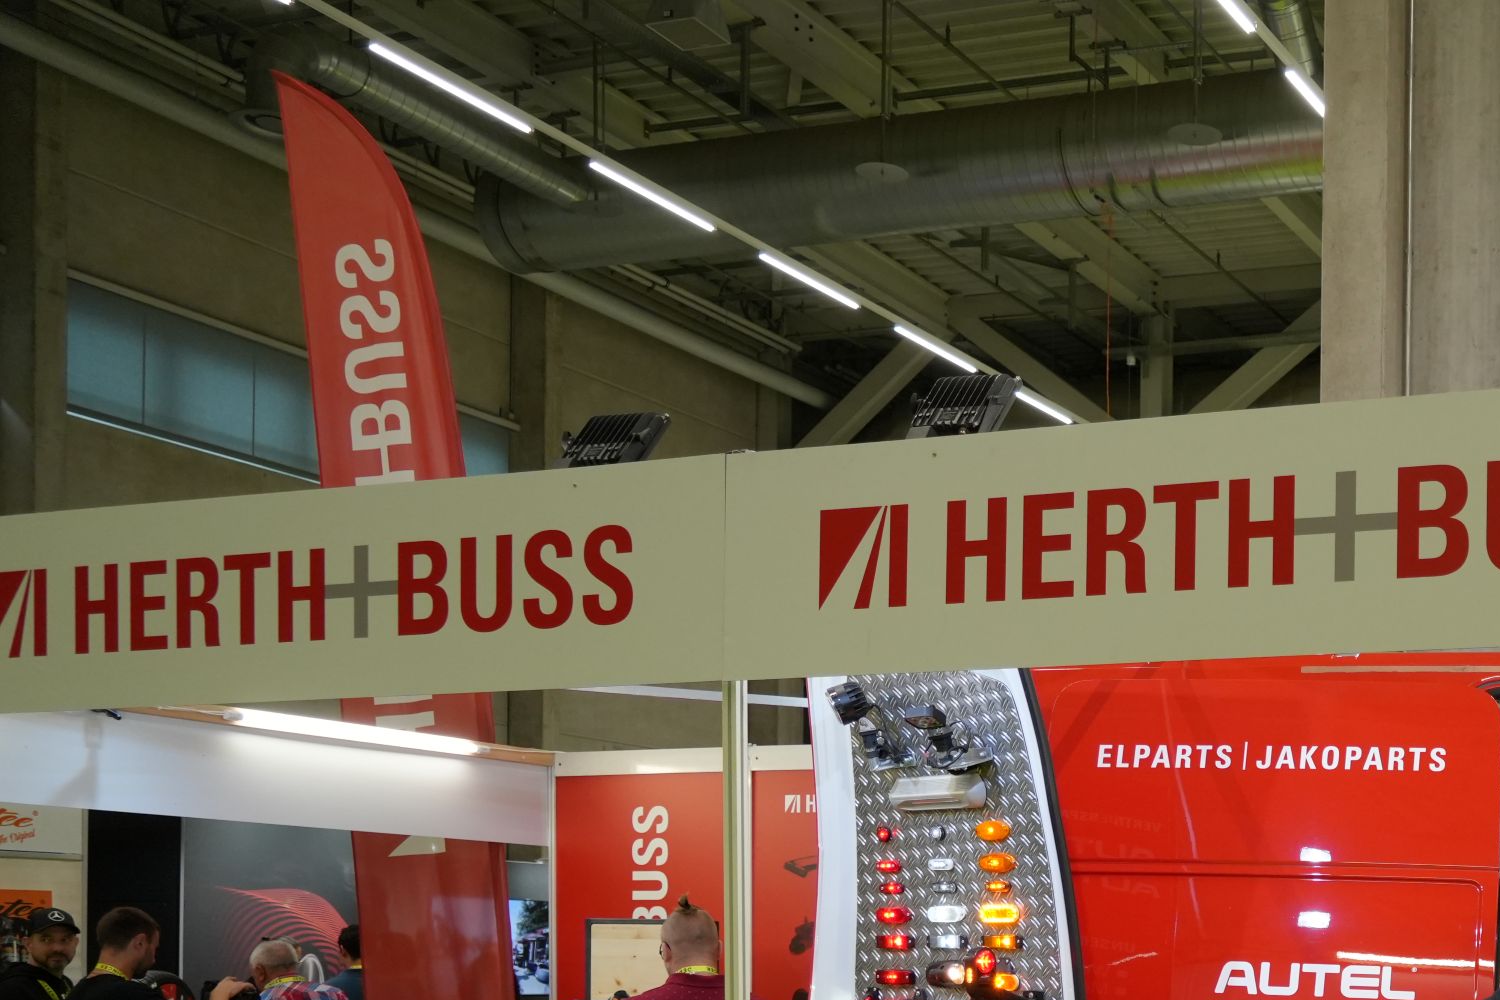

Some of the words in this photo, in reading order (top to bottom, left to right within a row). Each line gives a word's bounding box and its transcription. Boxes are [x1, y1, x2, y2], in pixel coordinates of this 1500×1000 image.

[74, 524, 634, 655] HERTH+BUSS
[1097, 744, 1233, 770] ELPARTS
[1256, 744, 1447, 772] JAKOPARTS
[1214, 960, 1416, 1000] AUTEL
